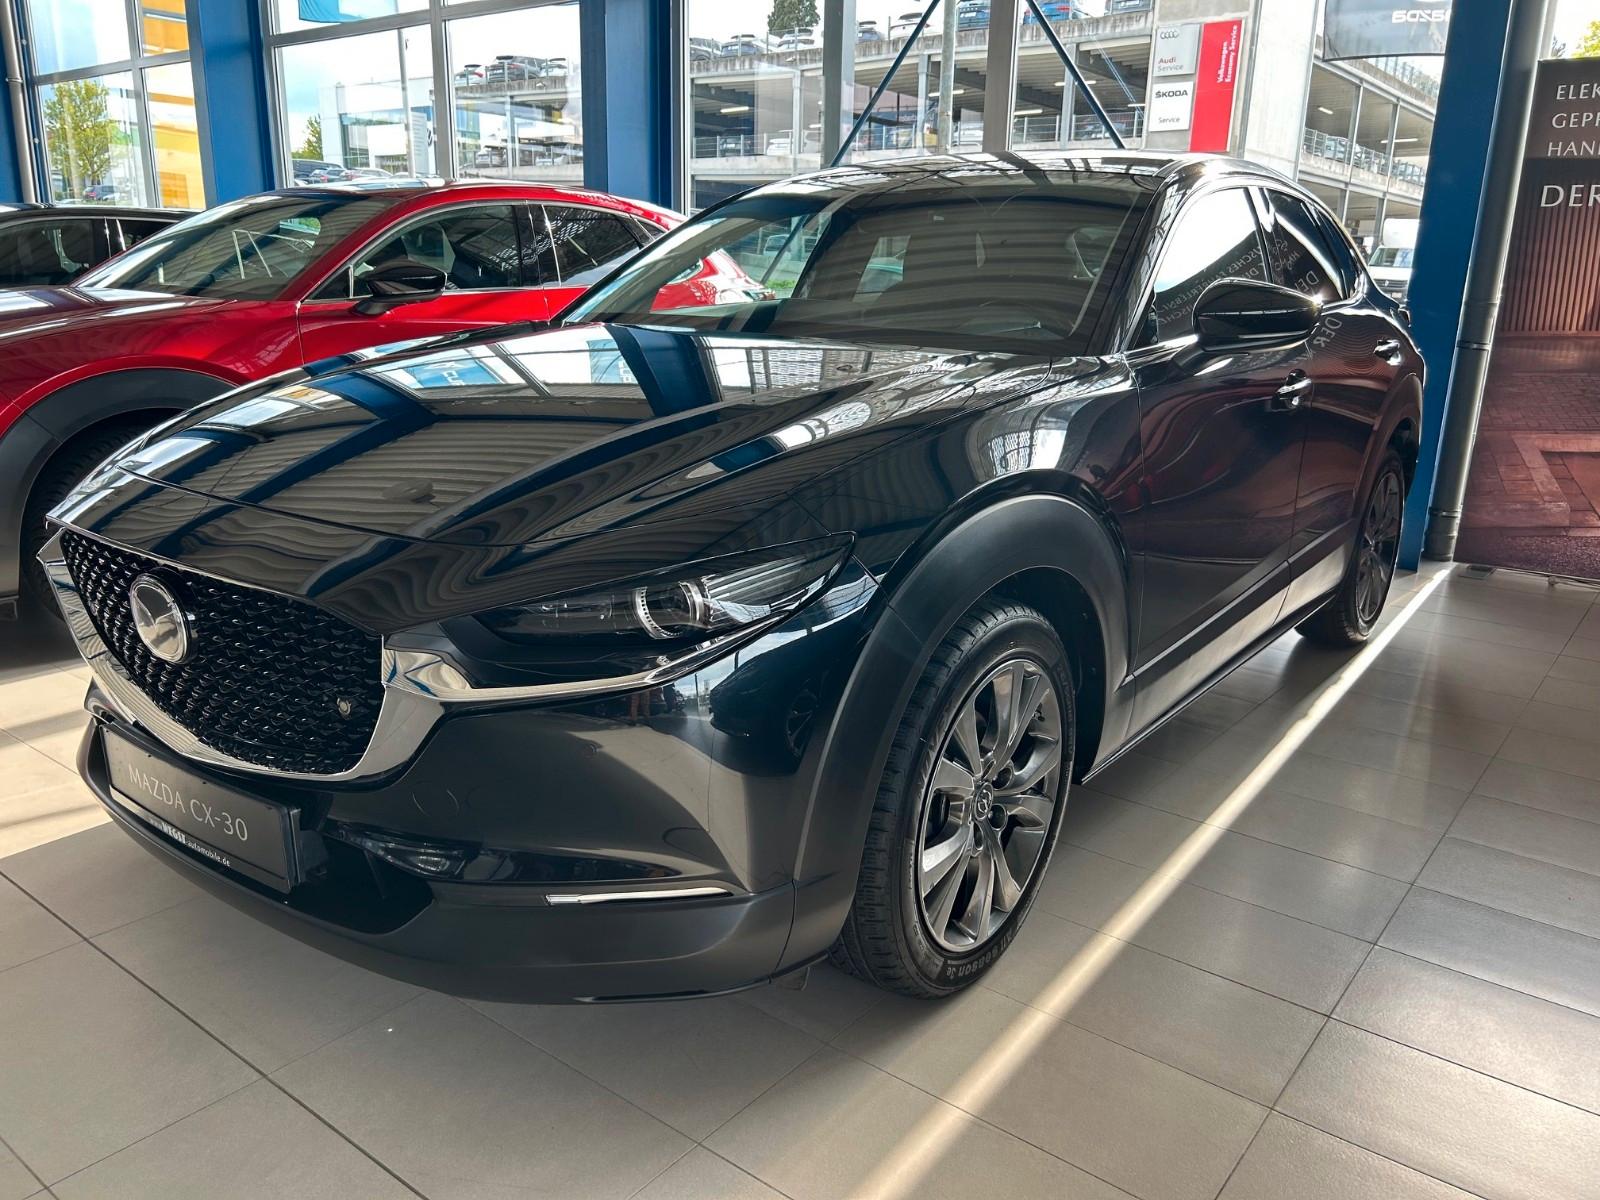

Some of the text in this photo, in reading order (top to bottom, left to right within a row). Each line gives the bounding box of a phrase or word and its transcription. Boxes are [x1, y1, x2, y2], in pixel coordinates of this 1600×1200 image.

[1158, 56, 1177, 65] Audi
[1225, 25, 1238, 83] Economy Service
[1158, 64, 1184, 73] Service
[1155, 89, 1189, 99] ŠKODA
[1547, 140, 1600, 157] HAN
[128, 763, 248, 841] MAZDA CX-30
